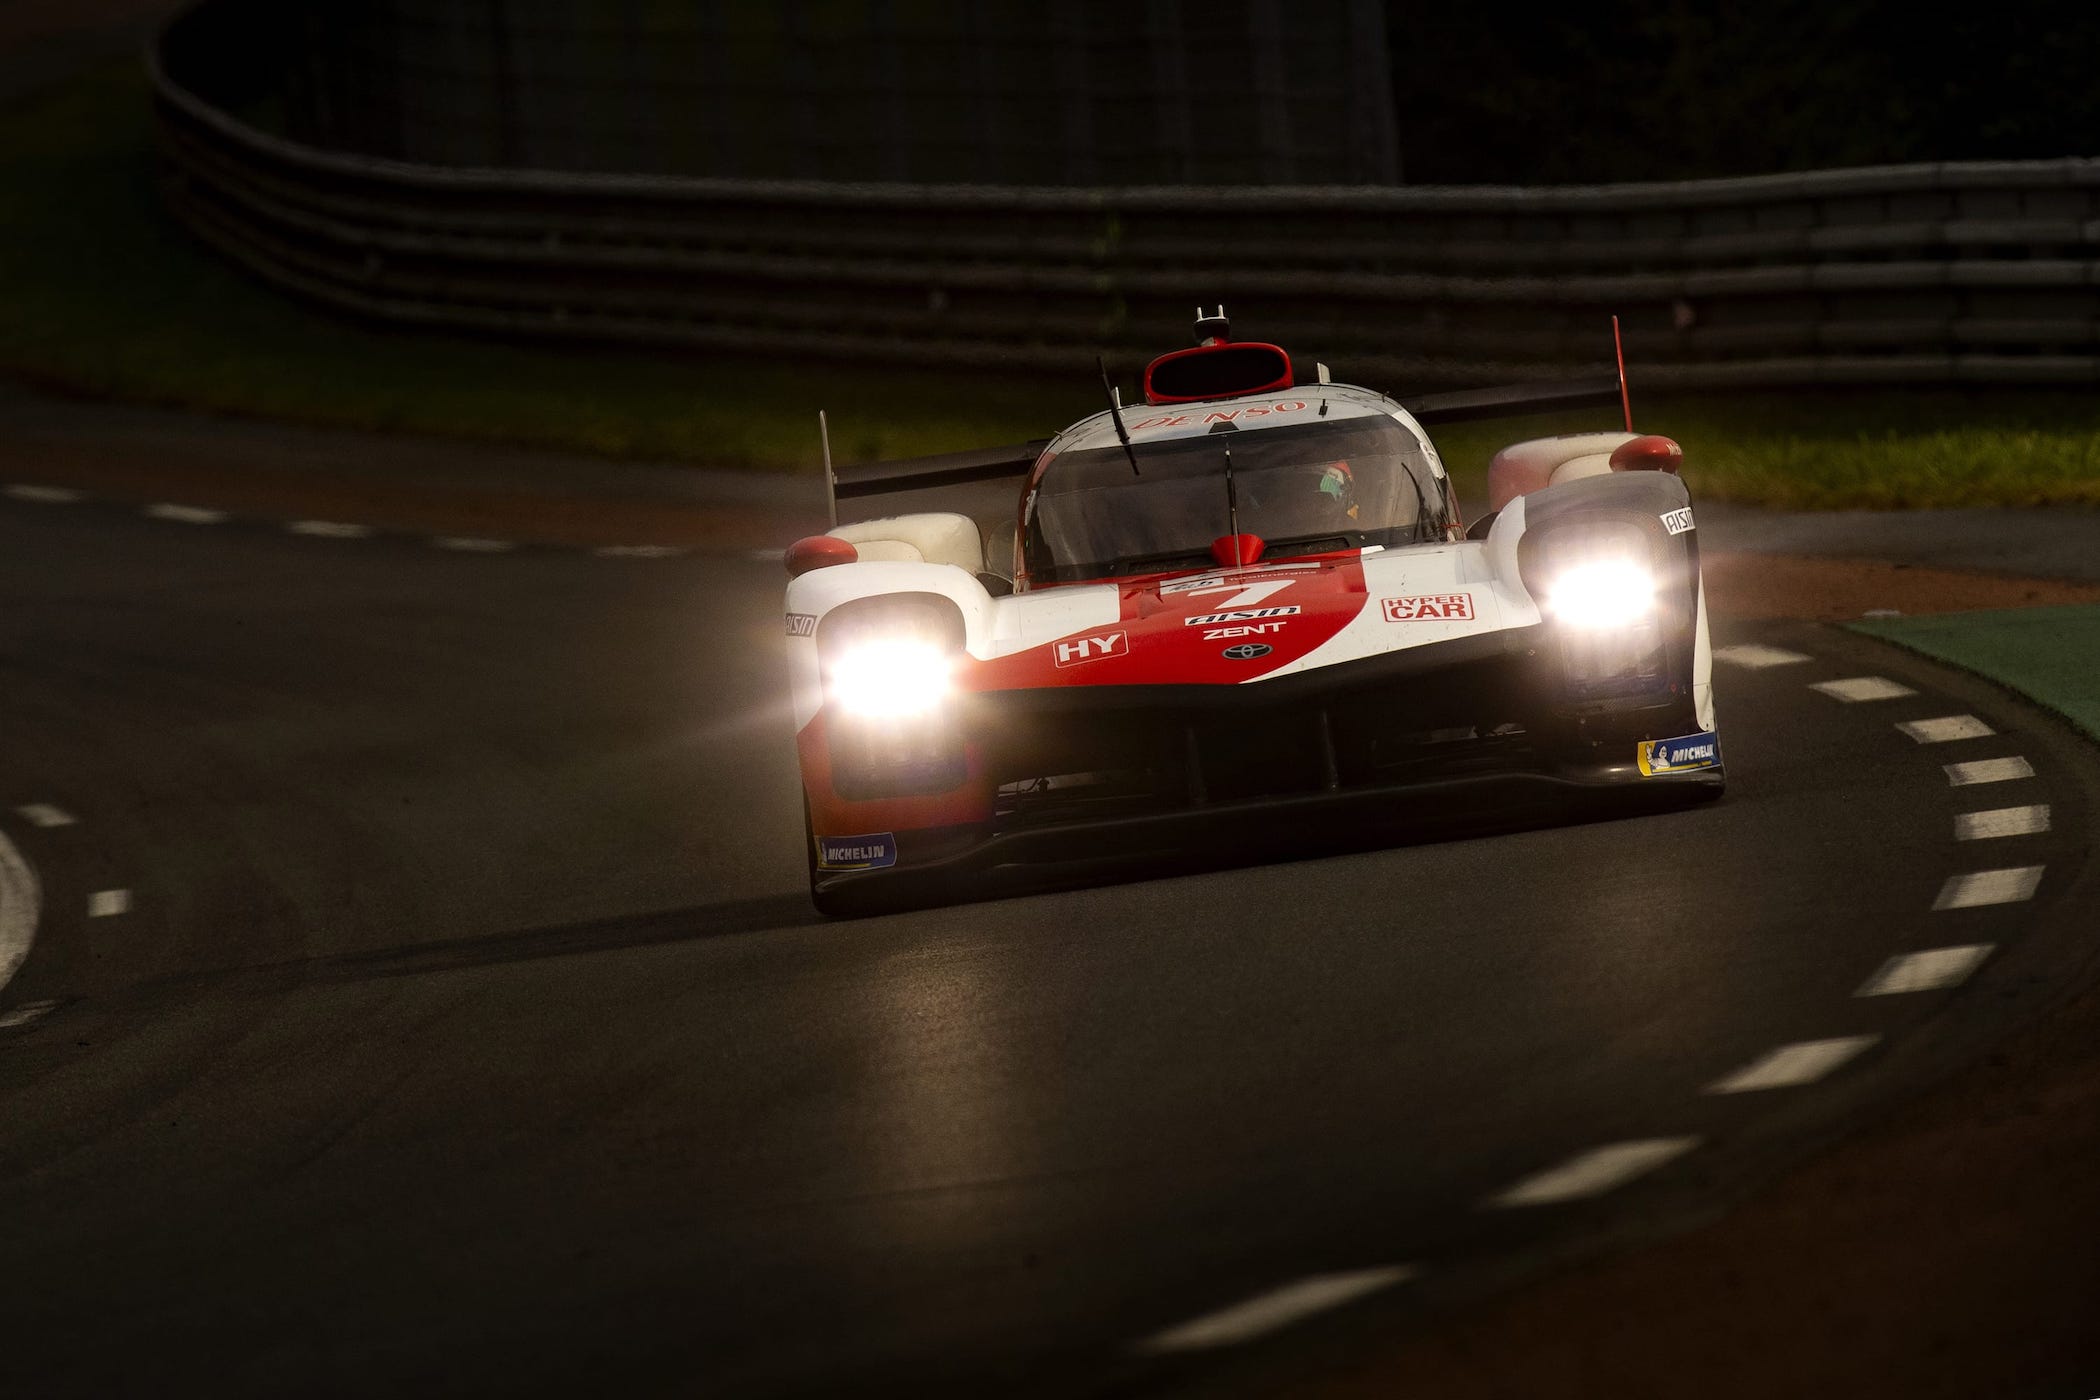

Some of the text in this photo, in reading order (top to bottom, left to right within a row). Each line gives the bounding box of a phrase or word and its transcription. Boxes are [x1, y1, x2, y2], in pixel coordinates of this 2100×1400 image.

[1131, 402, 1307, 430] DENSO
[1187, 579, 1296, 609] 7
[1387, 596, 1464, 606] HYPER
[1390, 603, 1467, 619] CAR
[1203, 622, 1287, 640] ZENT
[1058, 633, 1121, 662] HY
[1671, 743, 1714, 763] MICHELIN
[828, 845, 885, 860] MICHELIN
